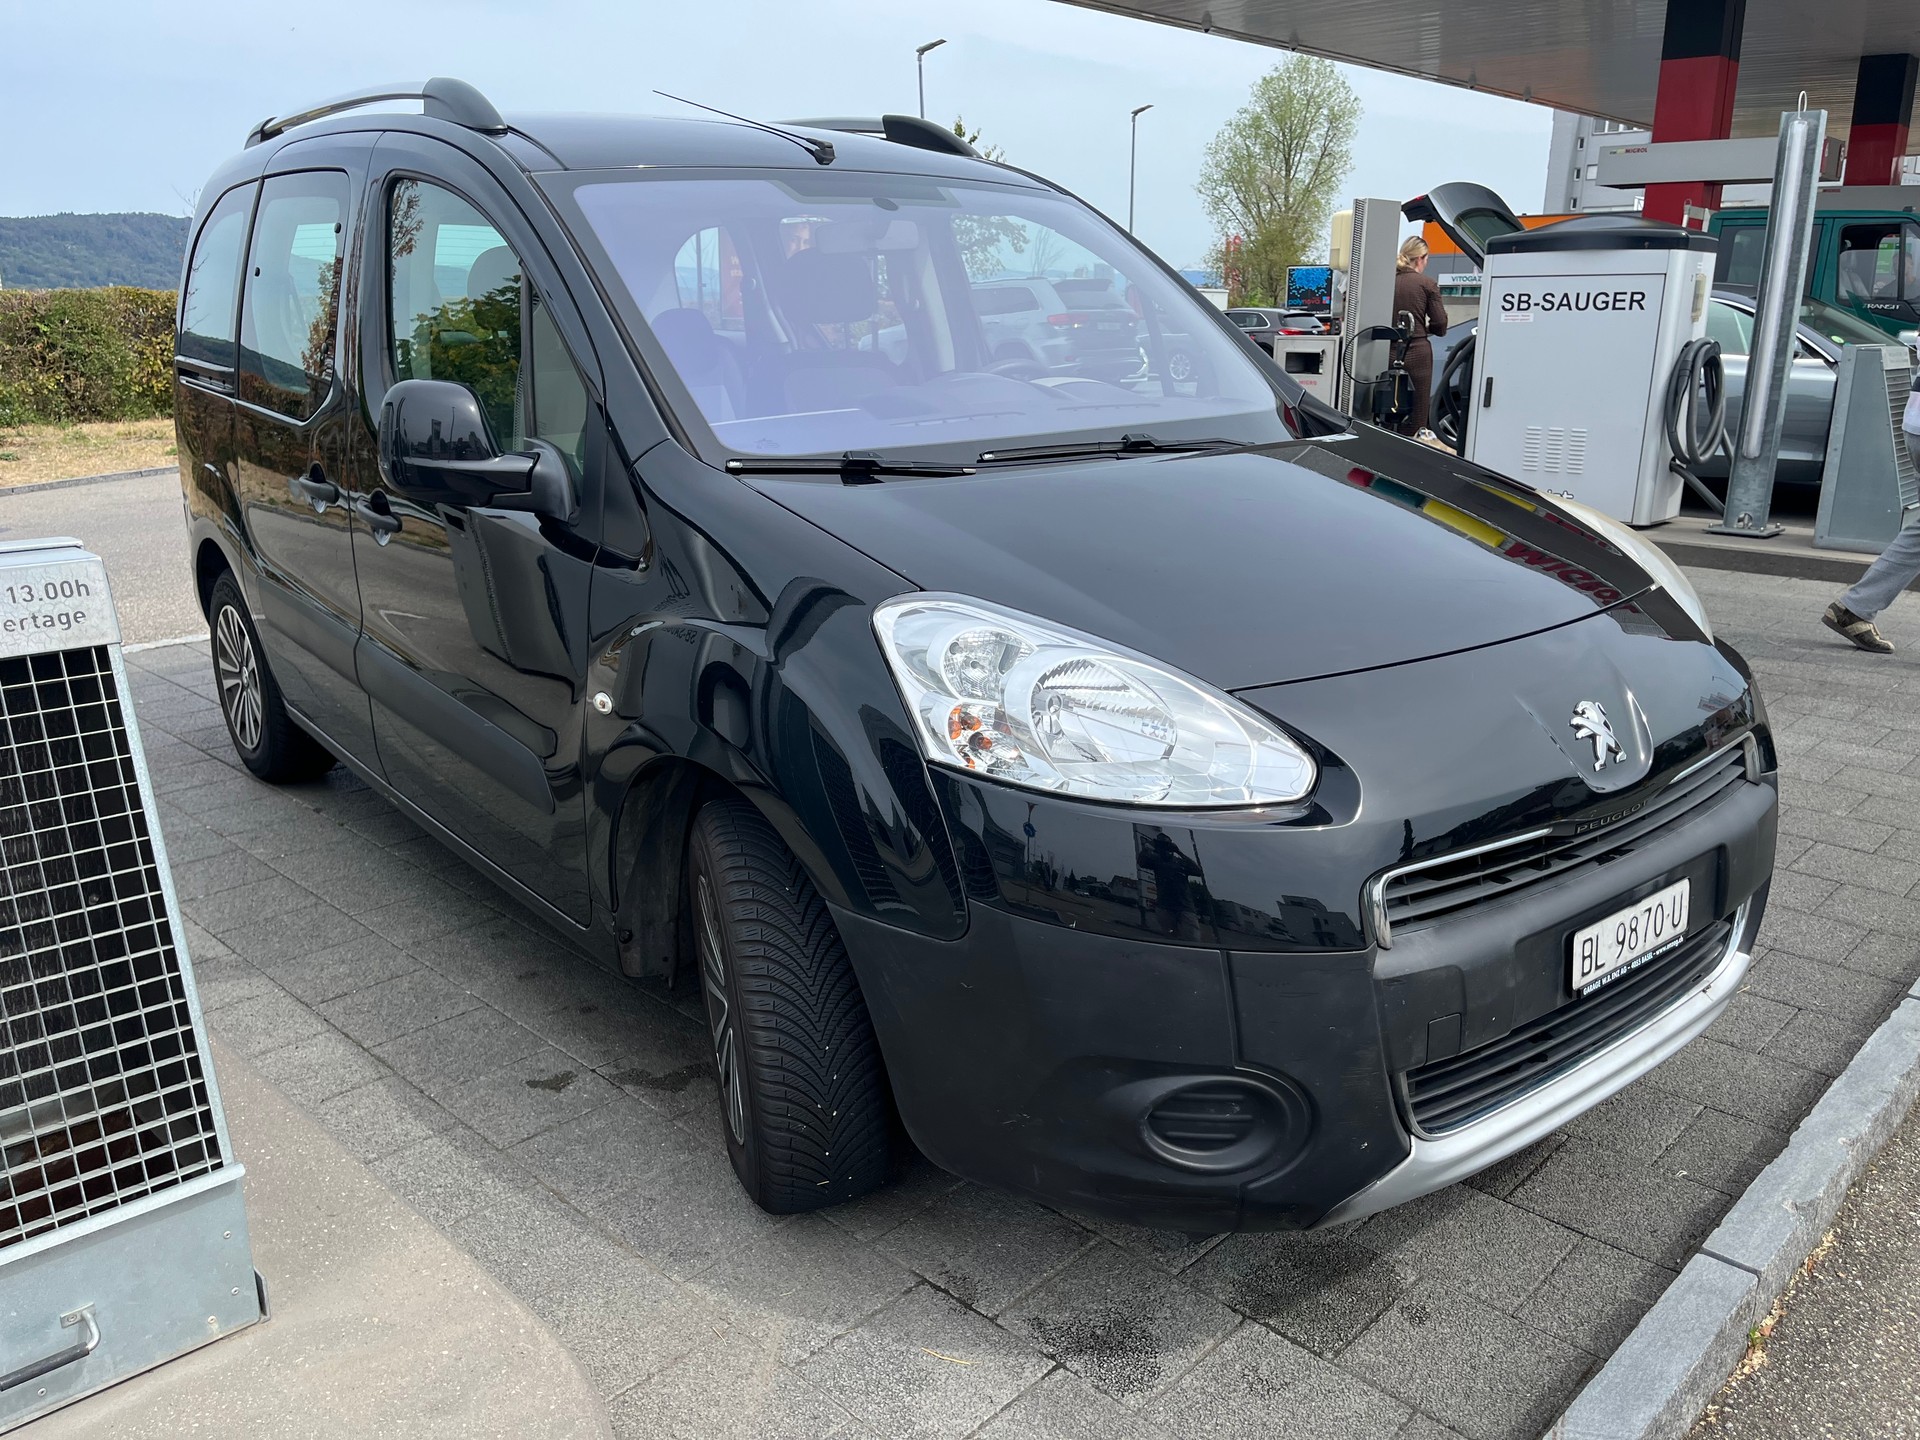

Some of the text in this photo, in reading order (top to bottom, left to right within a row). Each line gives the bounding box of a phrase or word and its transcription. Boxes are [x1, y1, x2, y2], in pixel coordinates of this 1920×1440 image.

[1501, 291, 1646, 312] SB-SAUGER
[6, 579, 91, 604] 13.00h
[3, 610, 87, 631] ertage
[1576, 800, 1648, 834] PEUGEOT
[1581, 933, 1606, 978] BL
[1583, 979, 1601, 996] GARAGE
